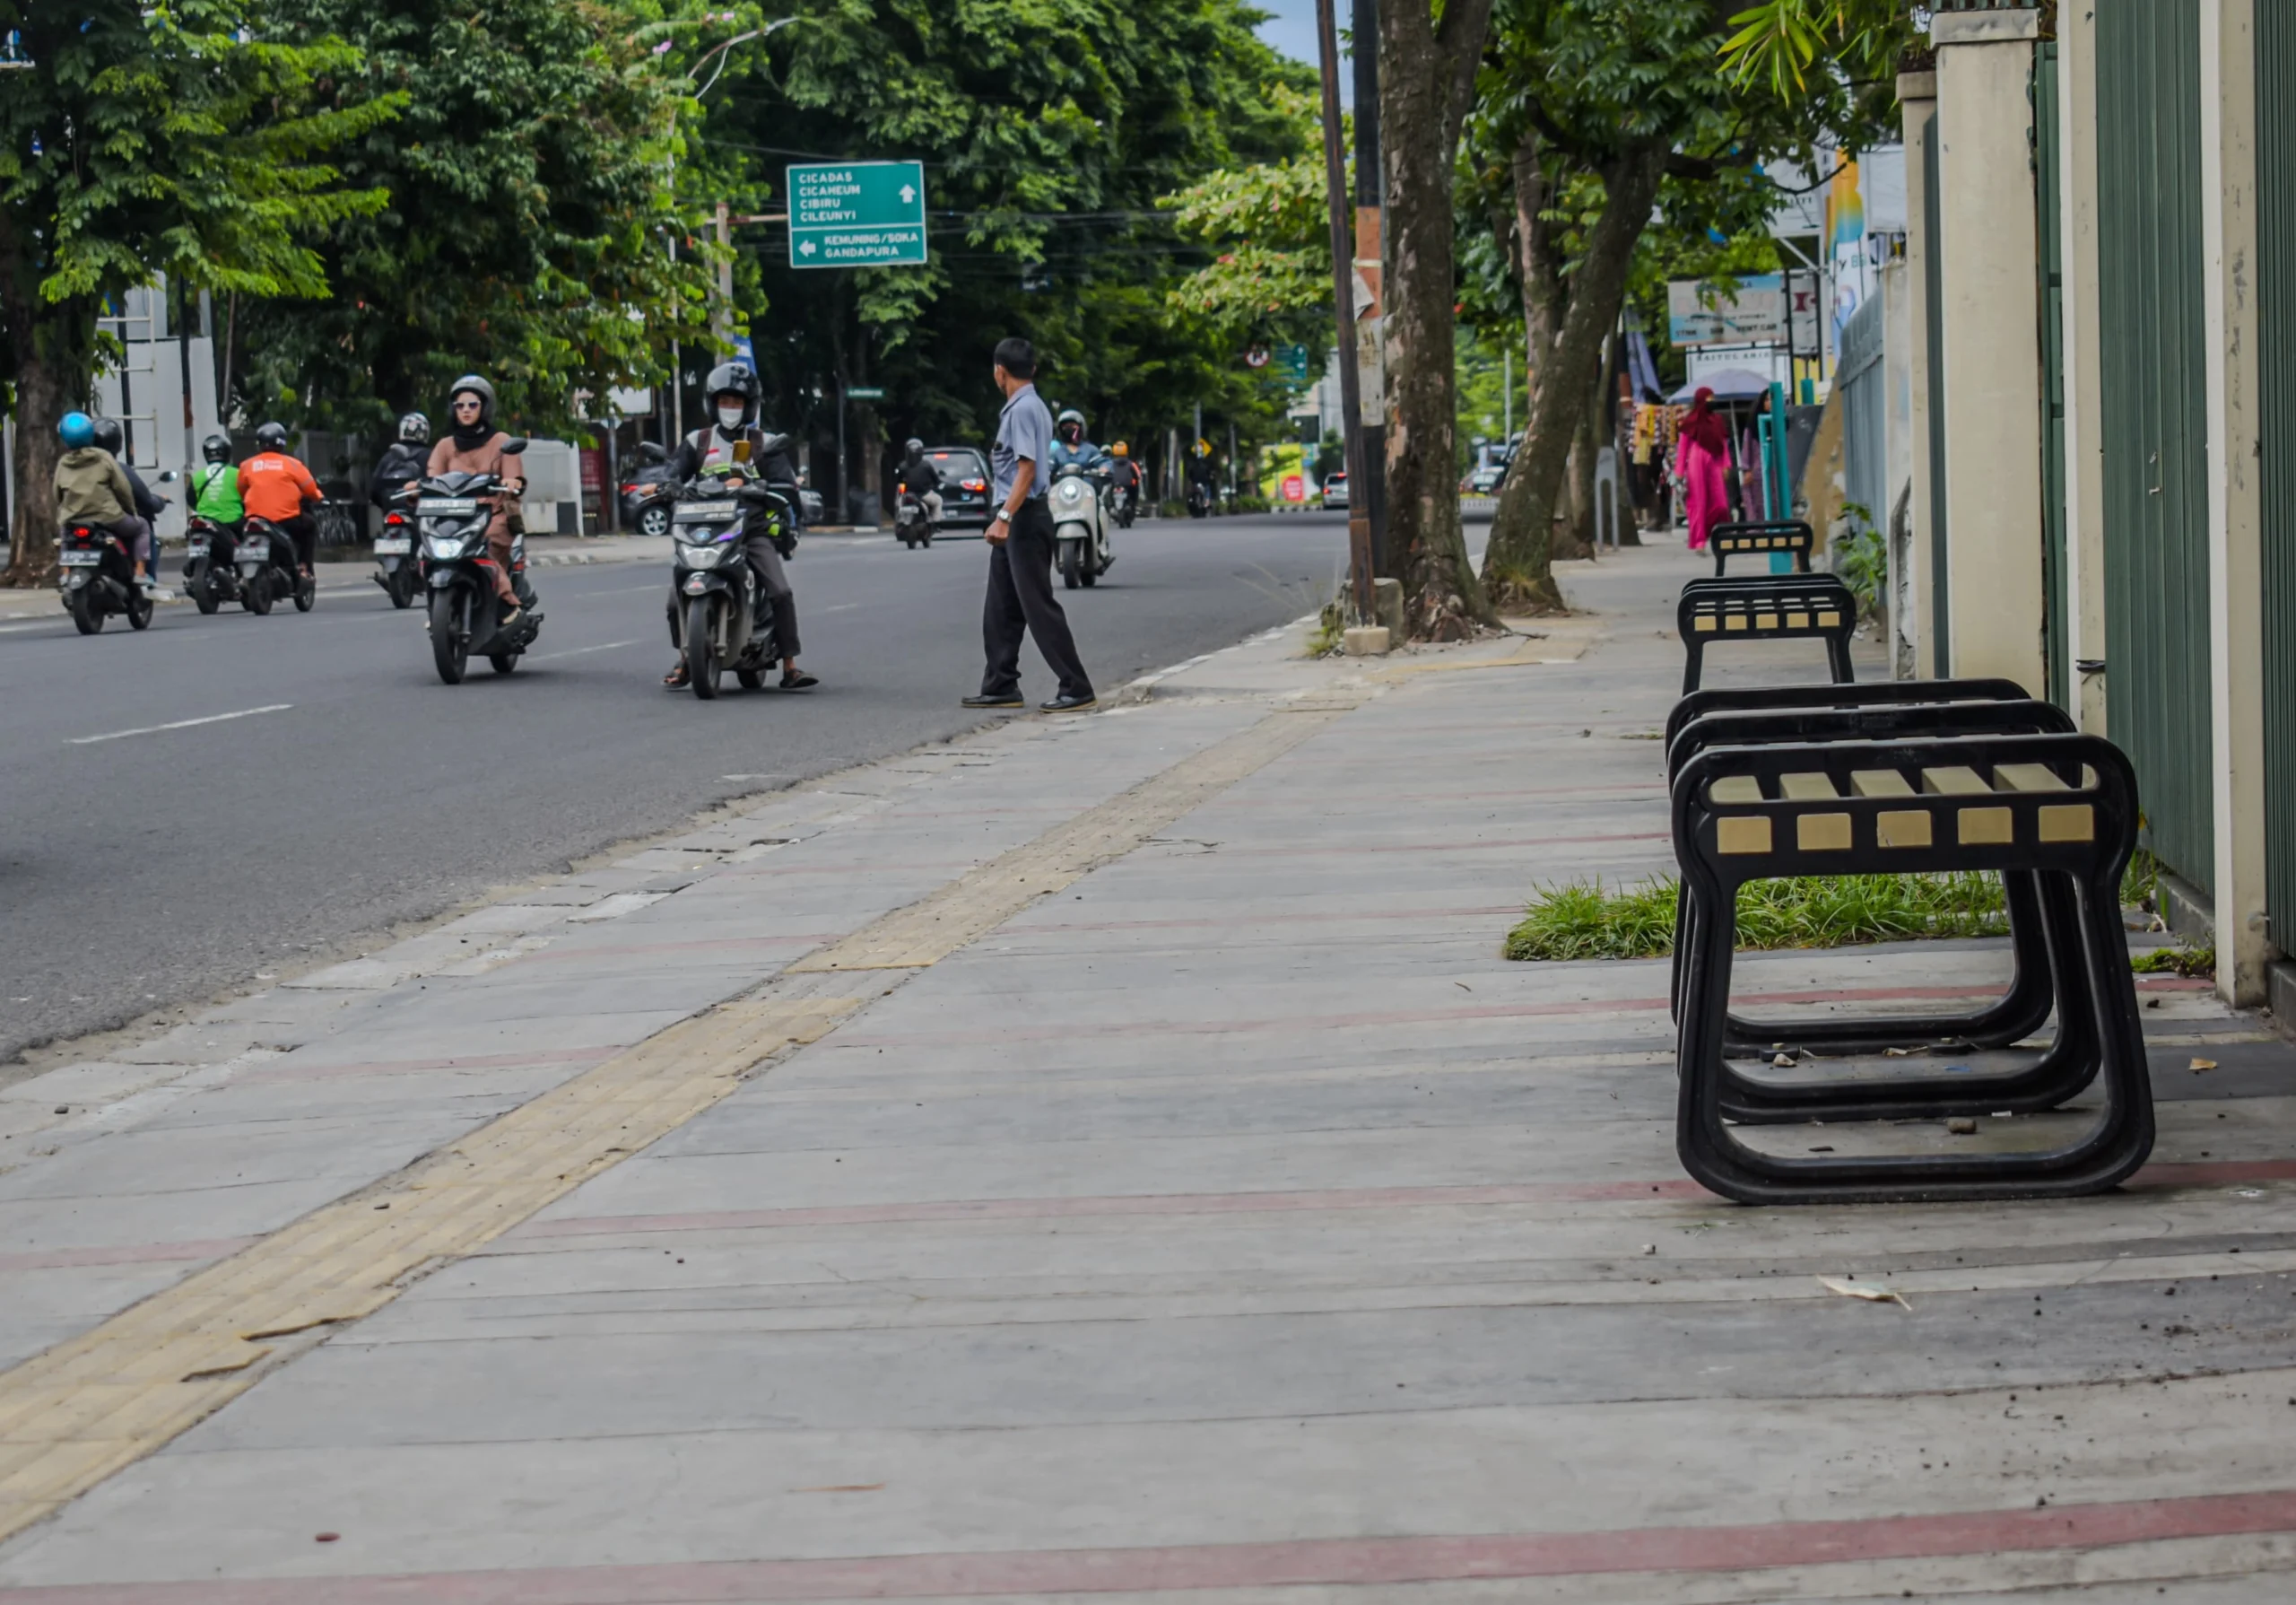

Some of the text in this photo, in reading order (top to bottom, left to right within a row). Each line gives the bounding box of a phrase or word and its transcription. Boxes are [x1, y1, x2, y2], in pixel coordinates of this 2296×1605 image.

[798, 171, 853, 184] CICADAS
[799, 185, 861, 196] CICAHEUM
[799, 198, 840, 209] CIBIRU
[800, 210, 857, 222] CILEUNYI
[825, 246, 900, 258] GANDAPURA
